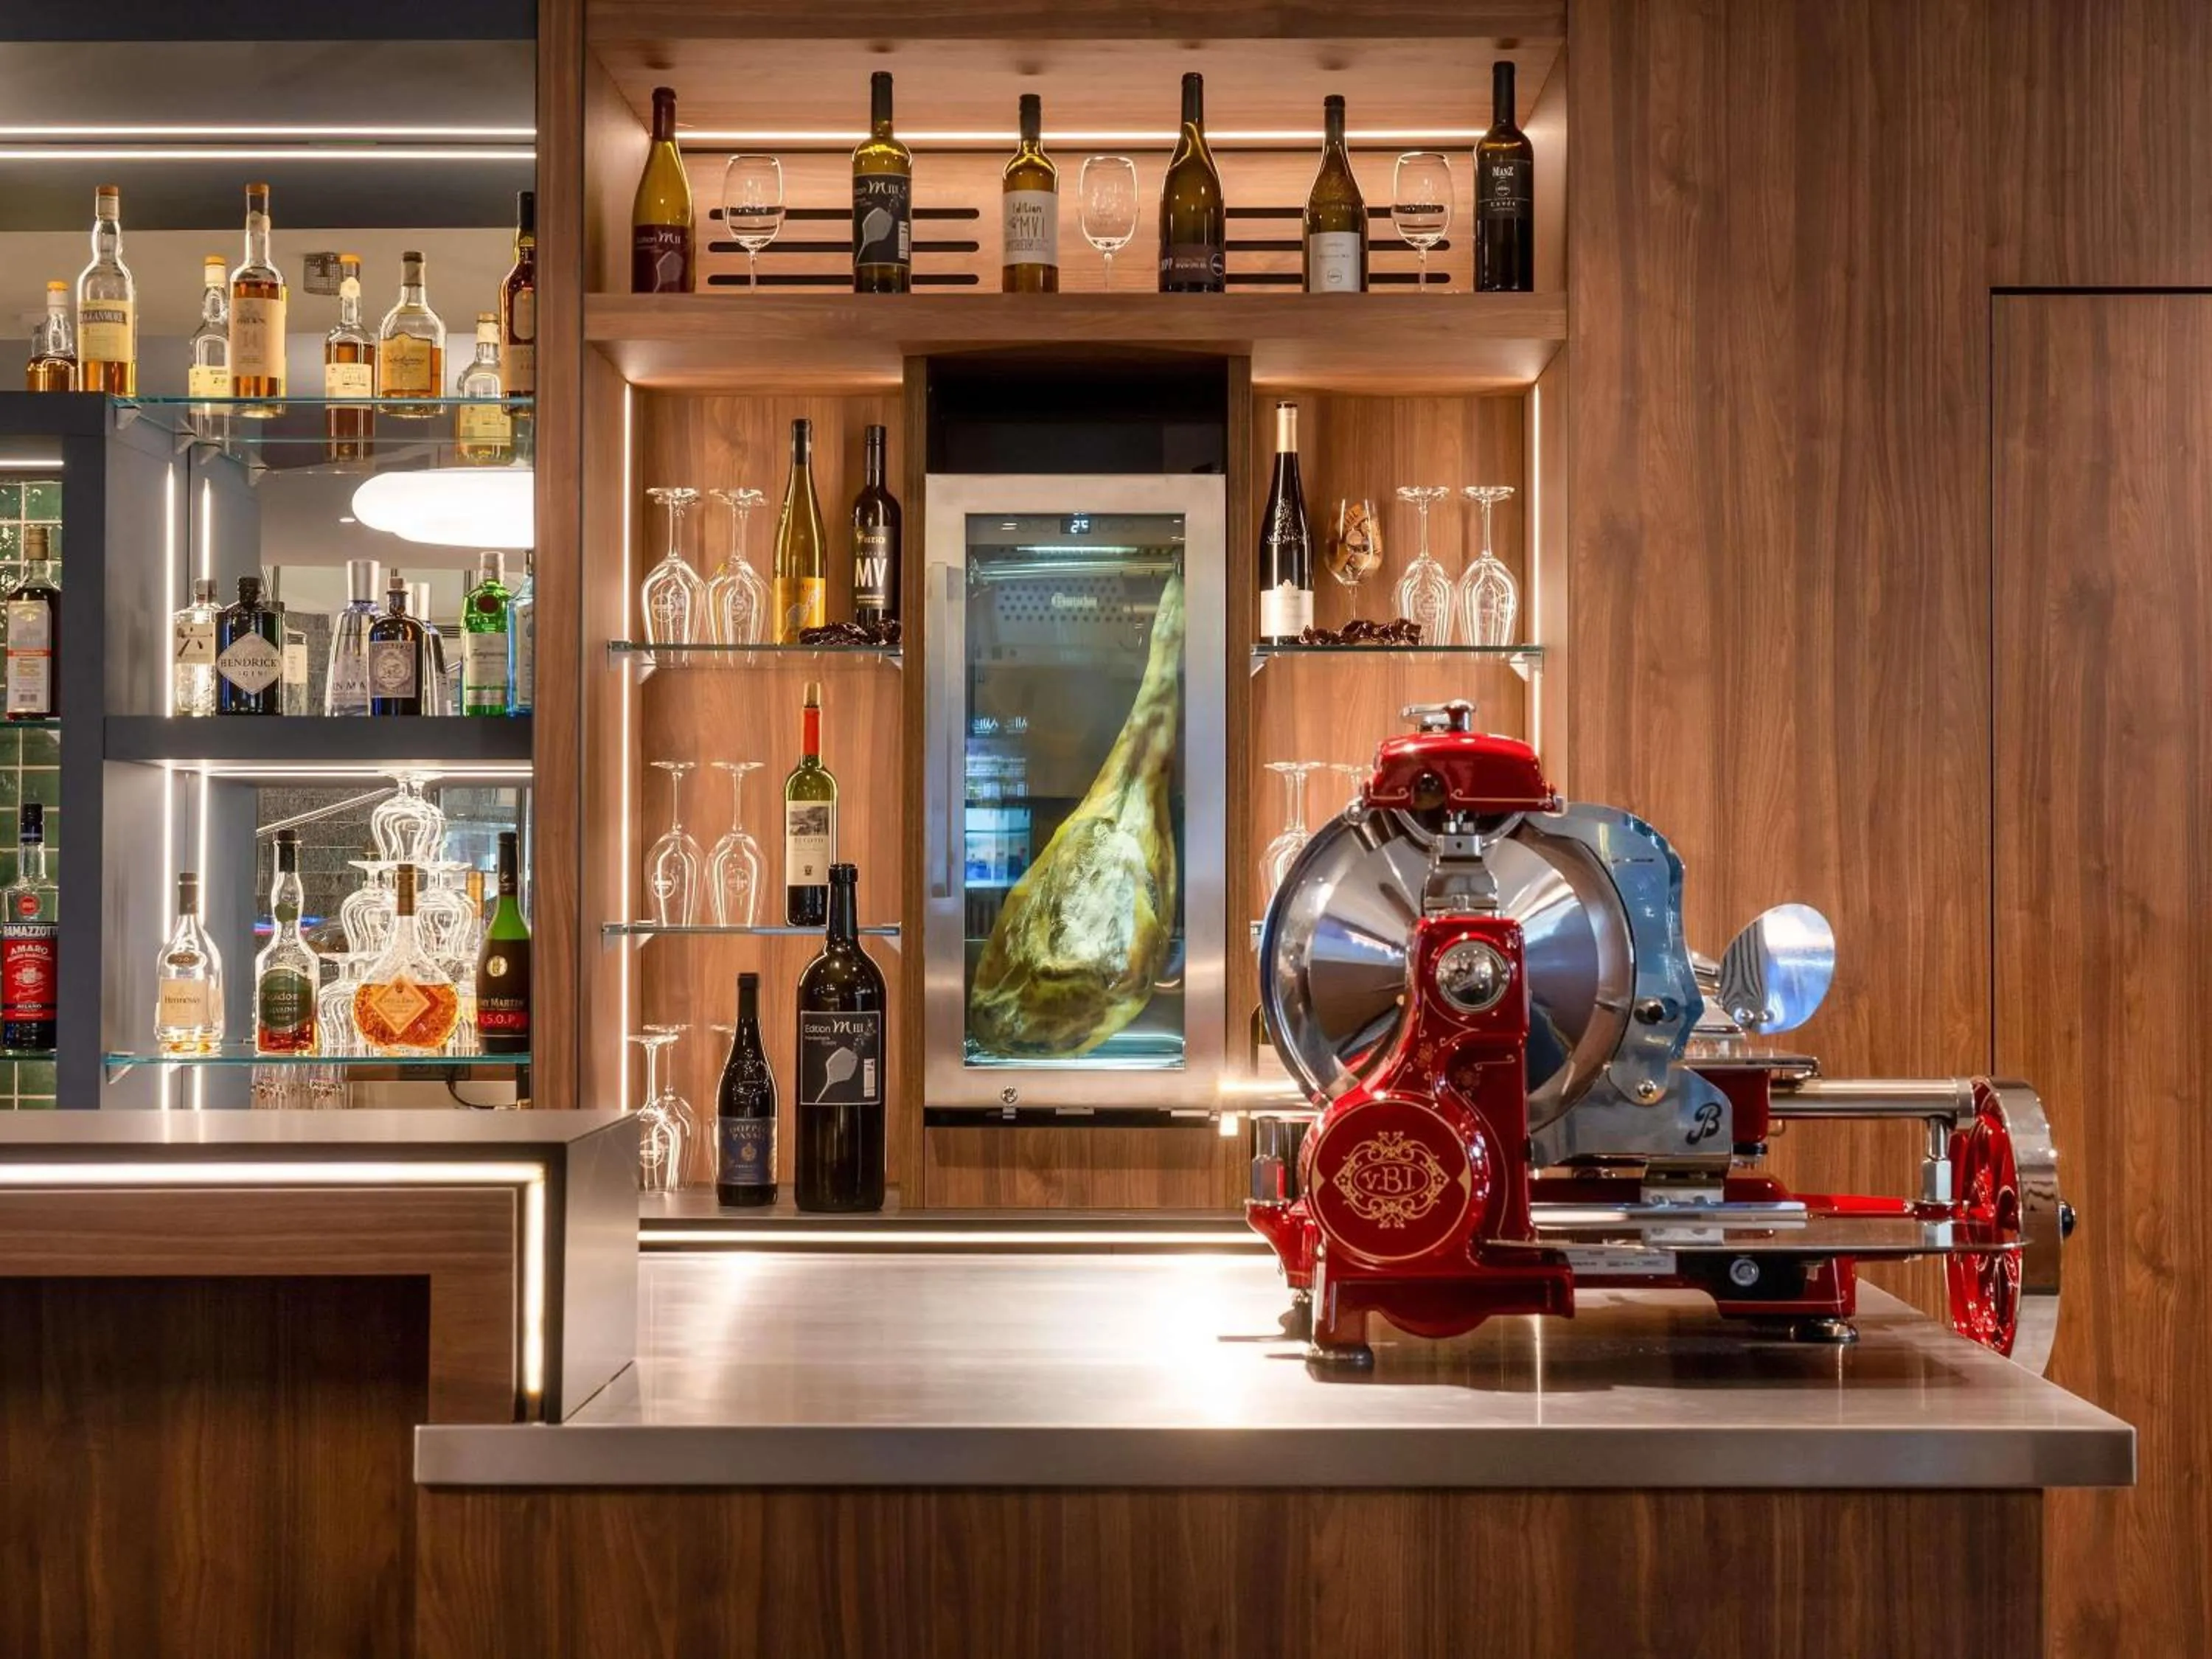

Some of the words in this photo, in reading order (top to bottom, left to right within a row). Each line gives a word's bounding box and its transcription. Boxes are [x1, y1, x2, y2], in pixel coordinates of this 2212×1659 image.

[854, 557, 887, 588] MV
[10, 945, 49, 956] AMARO
[804, 1023, 832, 1033] Edition
